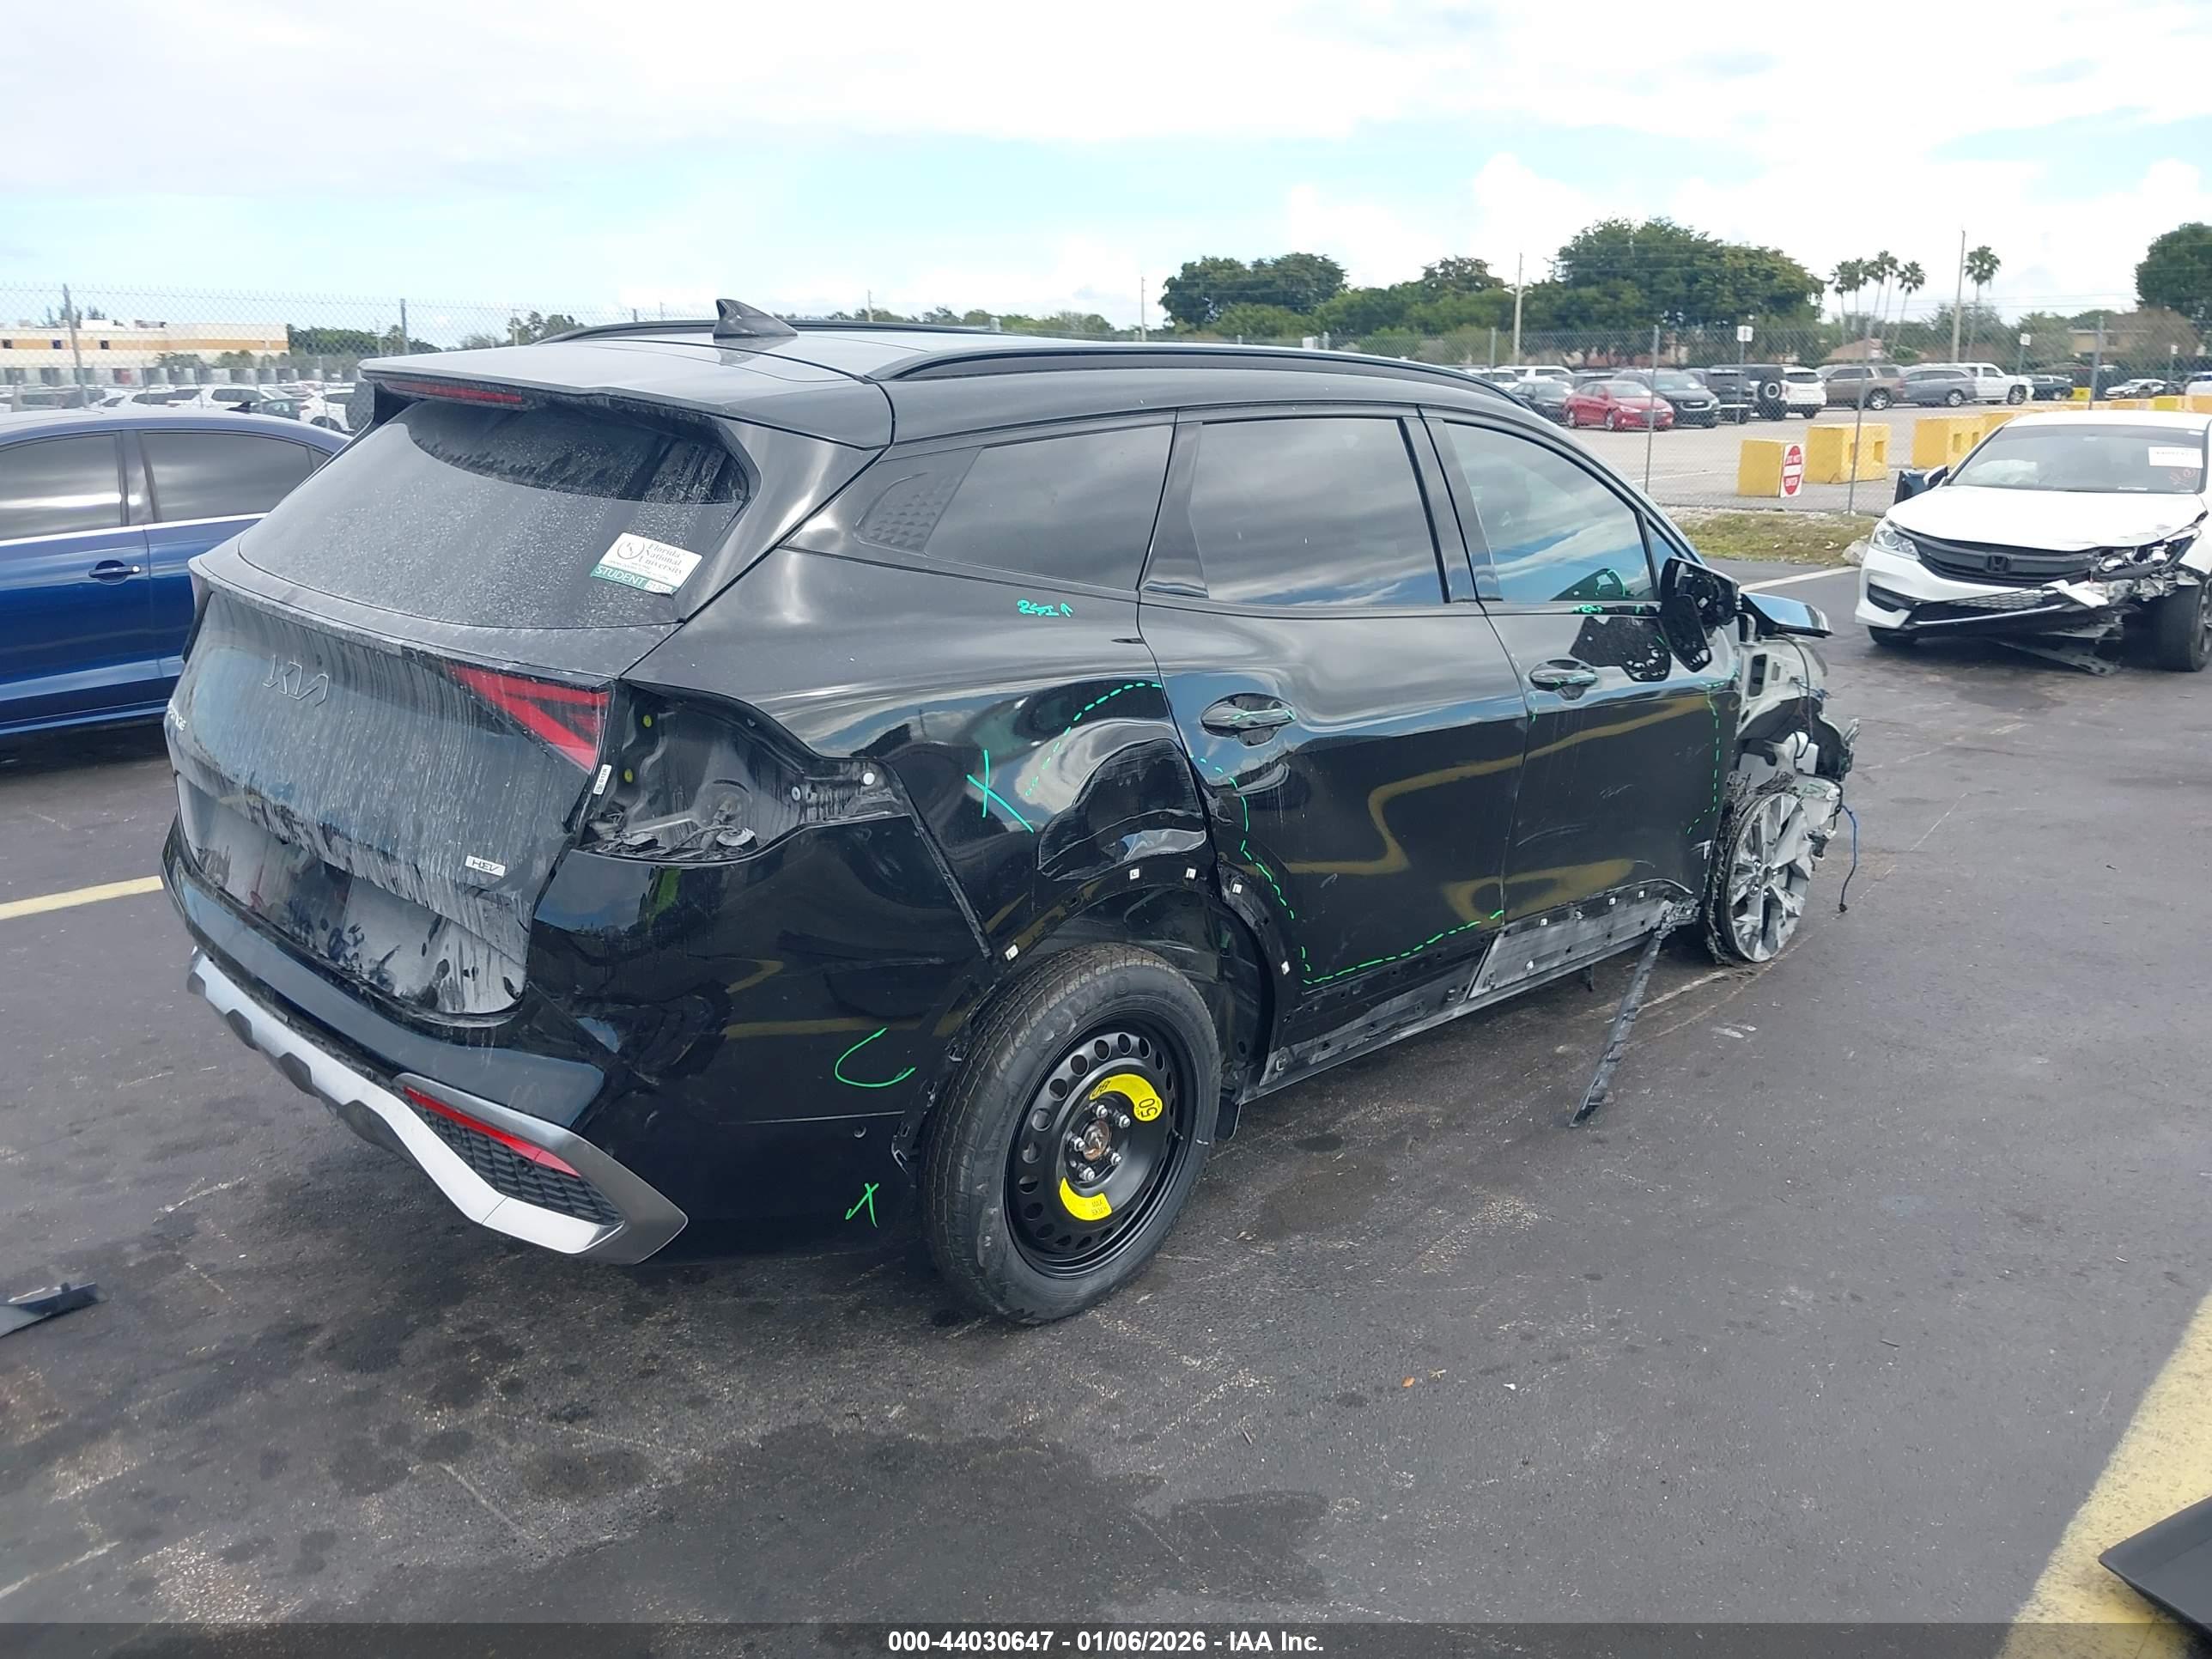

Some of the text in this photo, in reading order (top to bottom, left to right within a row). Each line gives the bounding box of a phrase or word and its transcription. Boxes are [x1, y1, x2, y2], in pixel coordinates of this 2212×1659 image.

[645, 550, 683, 566] National
[647, 543, 680, 558] Florida
[638, 556, 684, 576] University
[595, 565, 648, 586] STUDENT
[472, 859, 500, 872] HEV
[1139, 1098, 1158, 1118] 50
